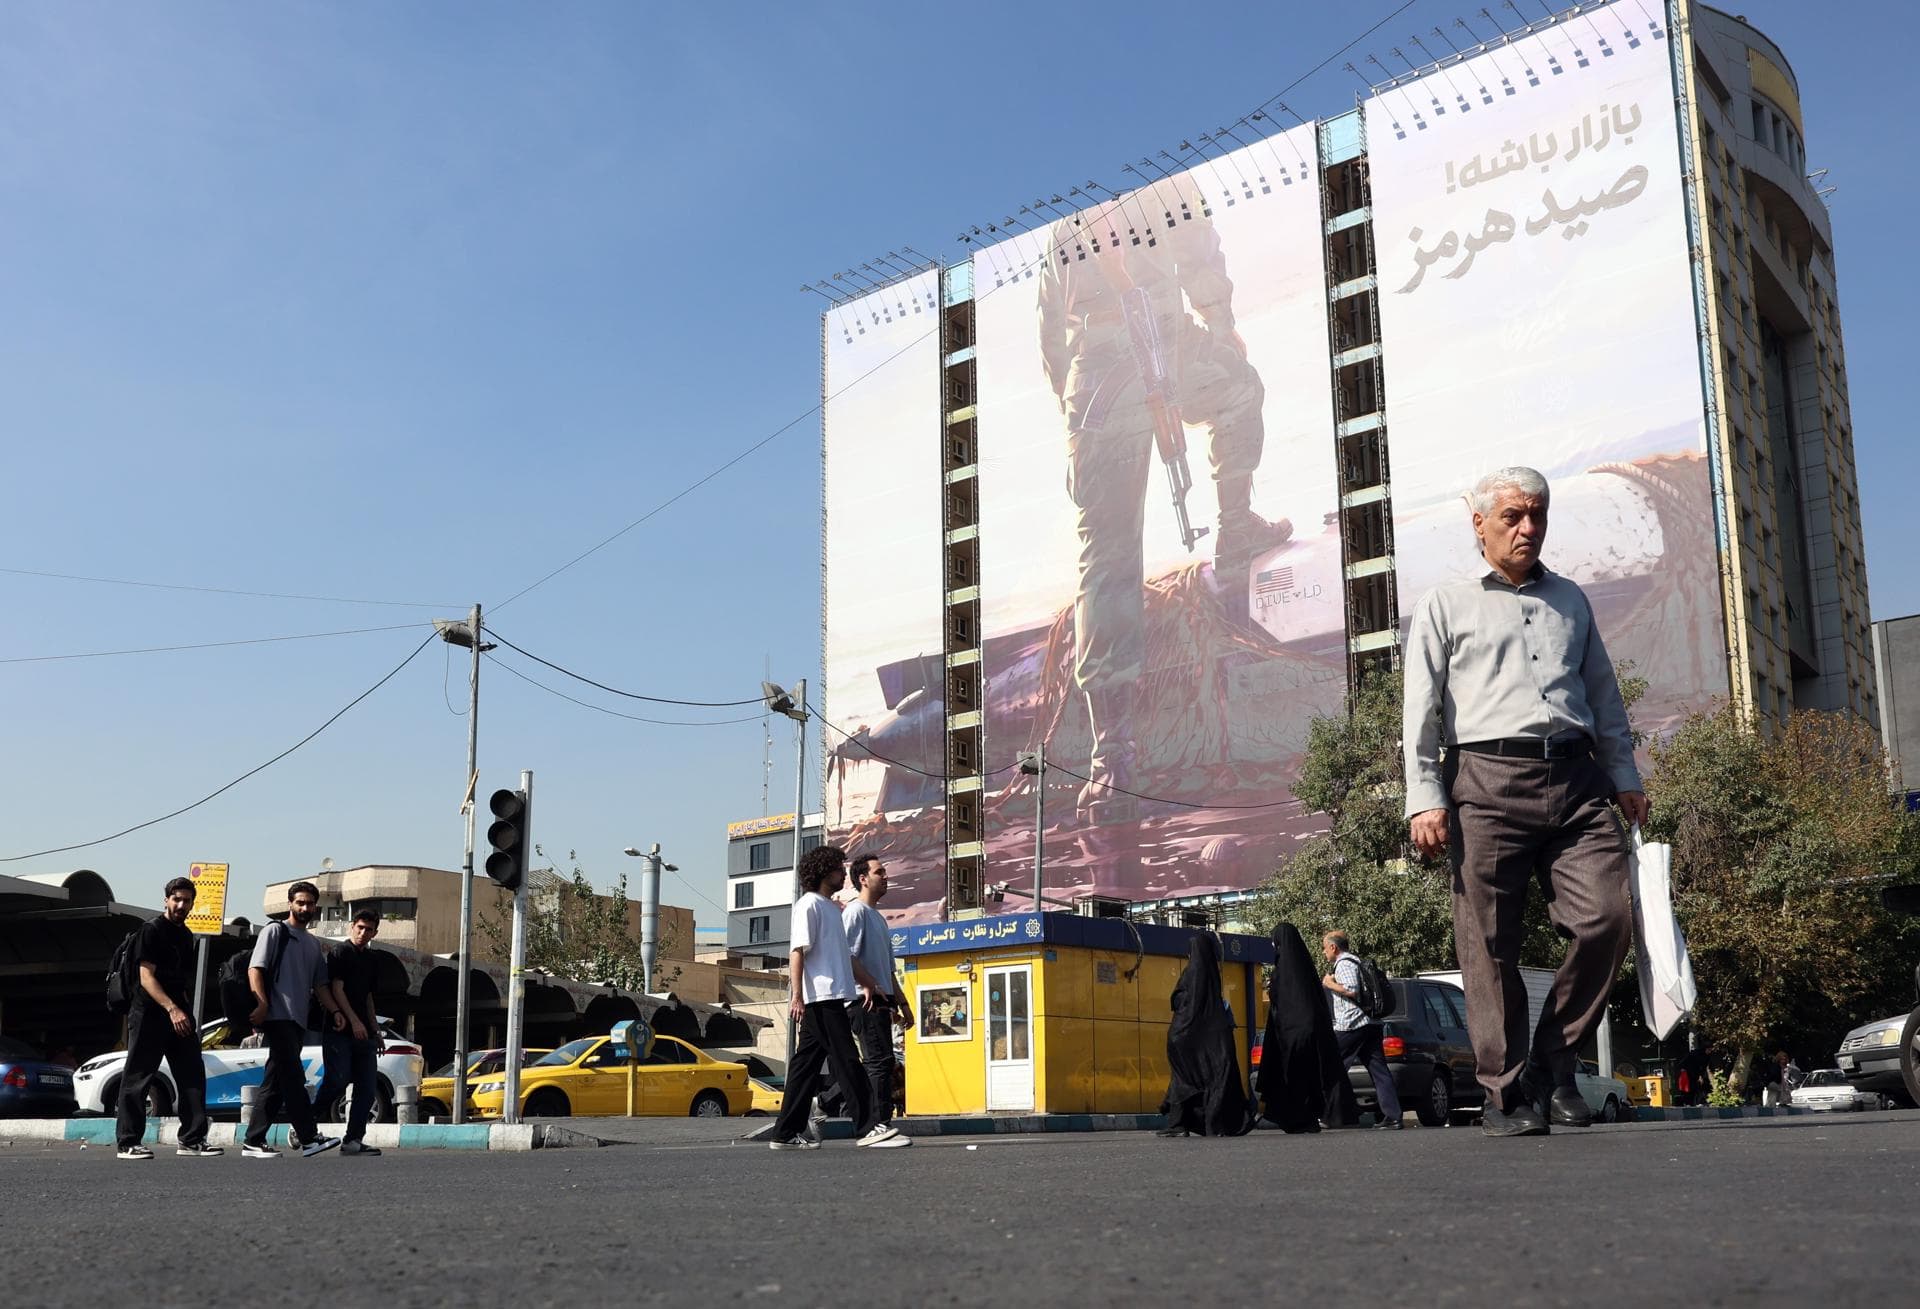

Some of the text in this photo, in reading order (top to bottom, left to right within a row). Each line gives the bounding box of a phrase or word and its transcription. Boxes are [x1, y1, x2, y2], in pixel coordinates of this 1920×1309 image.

[1445, 103, 1642, 194] بازار باشه!
[1392, 165, 1649, 294] صید هرمز
[919, 921, 1017, 945] کنترل و نظارت تاکسیرانی
